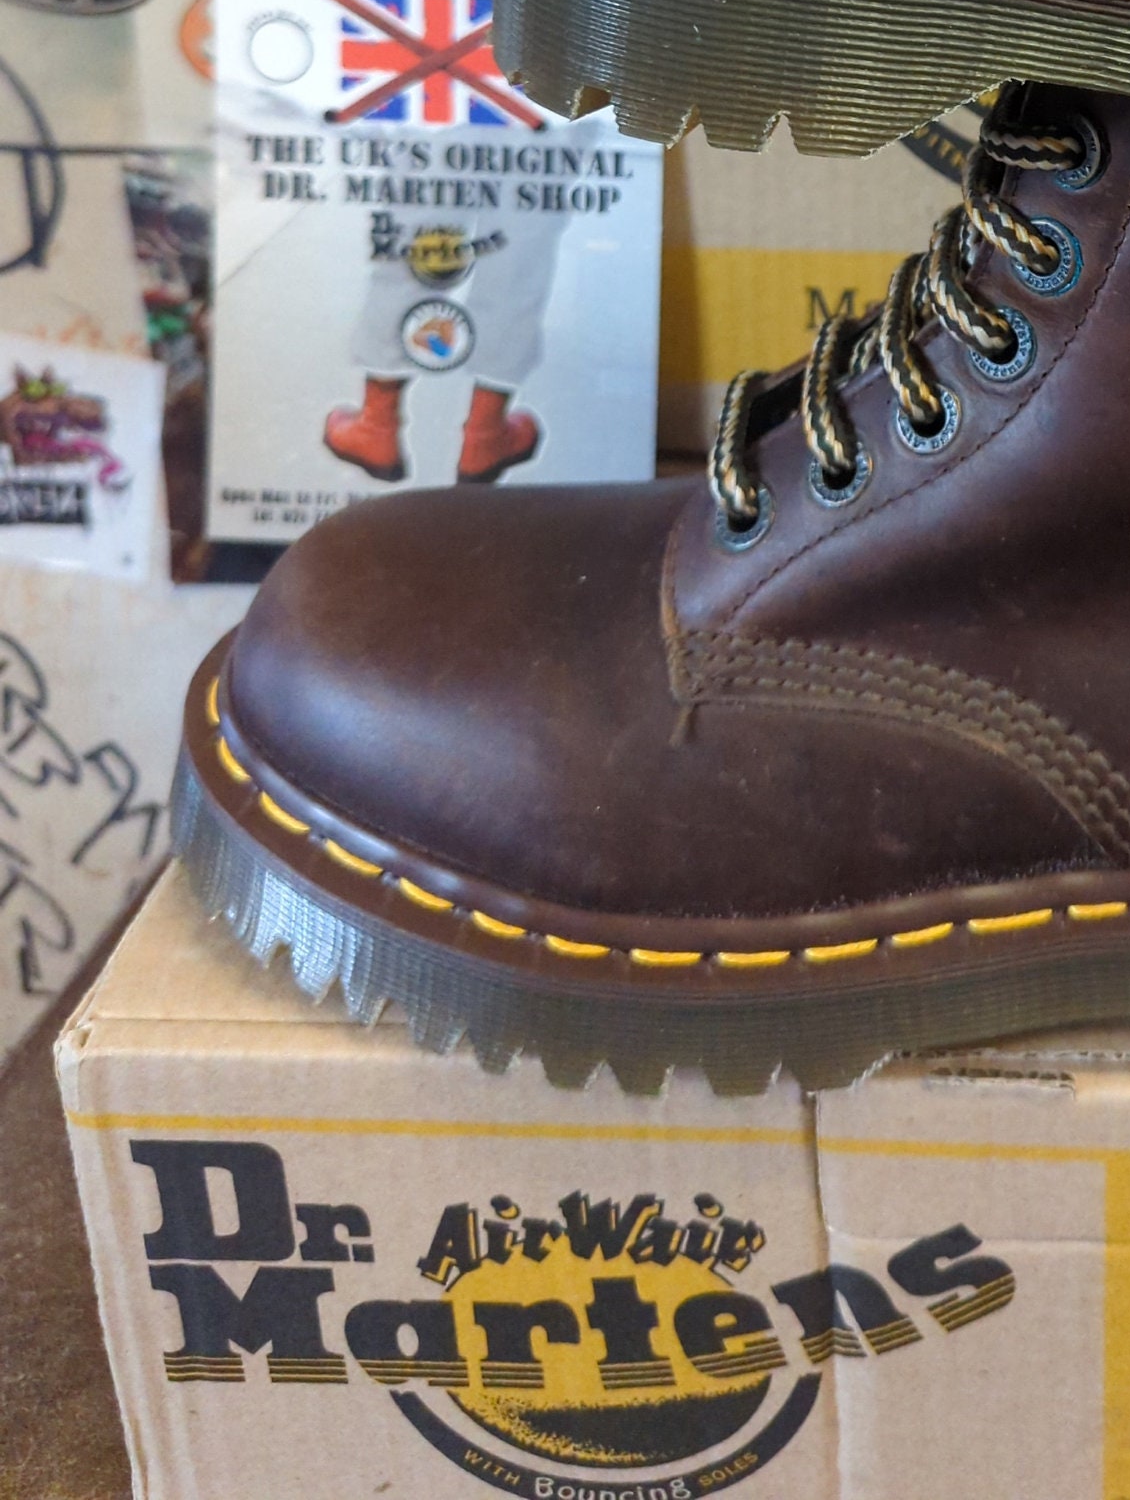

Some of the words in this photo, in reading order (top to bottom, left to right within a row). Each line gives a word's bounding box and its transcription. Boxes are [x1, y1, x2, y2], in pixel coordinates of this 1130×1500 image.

[247, 134, 326, 166] THE
[340, 137, 431, 171] UK'S
[445, 141, 634, 180] ORIGINAL
[261, 171, 328, 202] DR.
[346, 173, 502, 209] MARTEN
[516, 181, 623, 215] SHOP
[130, 1138, 375, 1264] Dr.
[416, 1189, 768, 1290] AirWair
[148, 1222, 1016, 1390] Martens
[463, 1449, 522, 1486] WITH
[534, 1476, 692, 1500] Bouncing
[698, 1451, 759, 1488] SOLES
